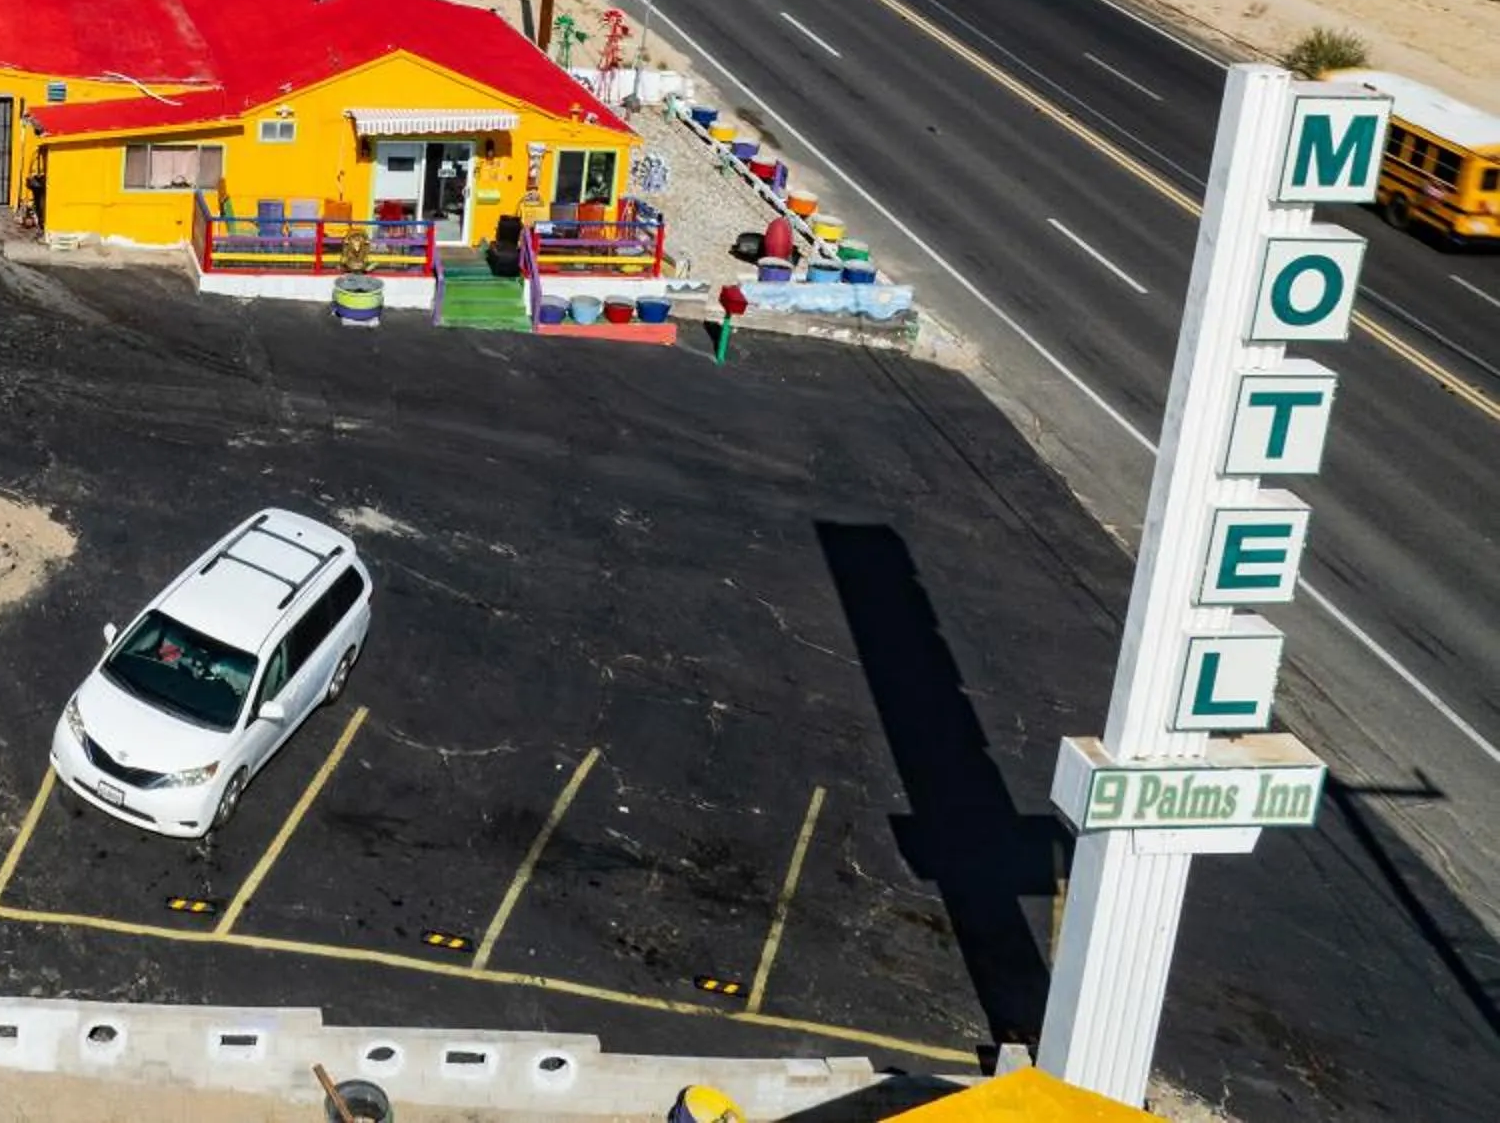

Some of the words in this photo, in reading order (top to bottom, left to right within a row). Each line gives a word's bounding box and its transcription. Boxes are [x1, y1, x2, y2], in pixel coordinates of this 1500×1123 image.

[1191, 114, 1378, 715] MOTEL
[1091, 775, 1127, 819] 9
[1134, 774, 1239, 819] Palms
[1252, 773, 1312, 818] Inn
